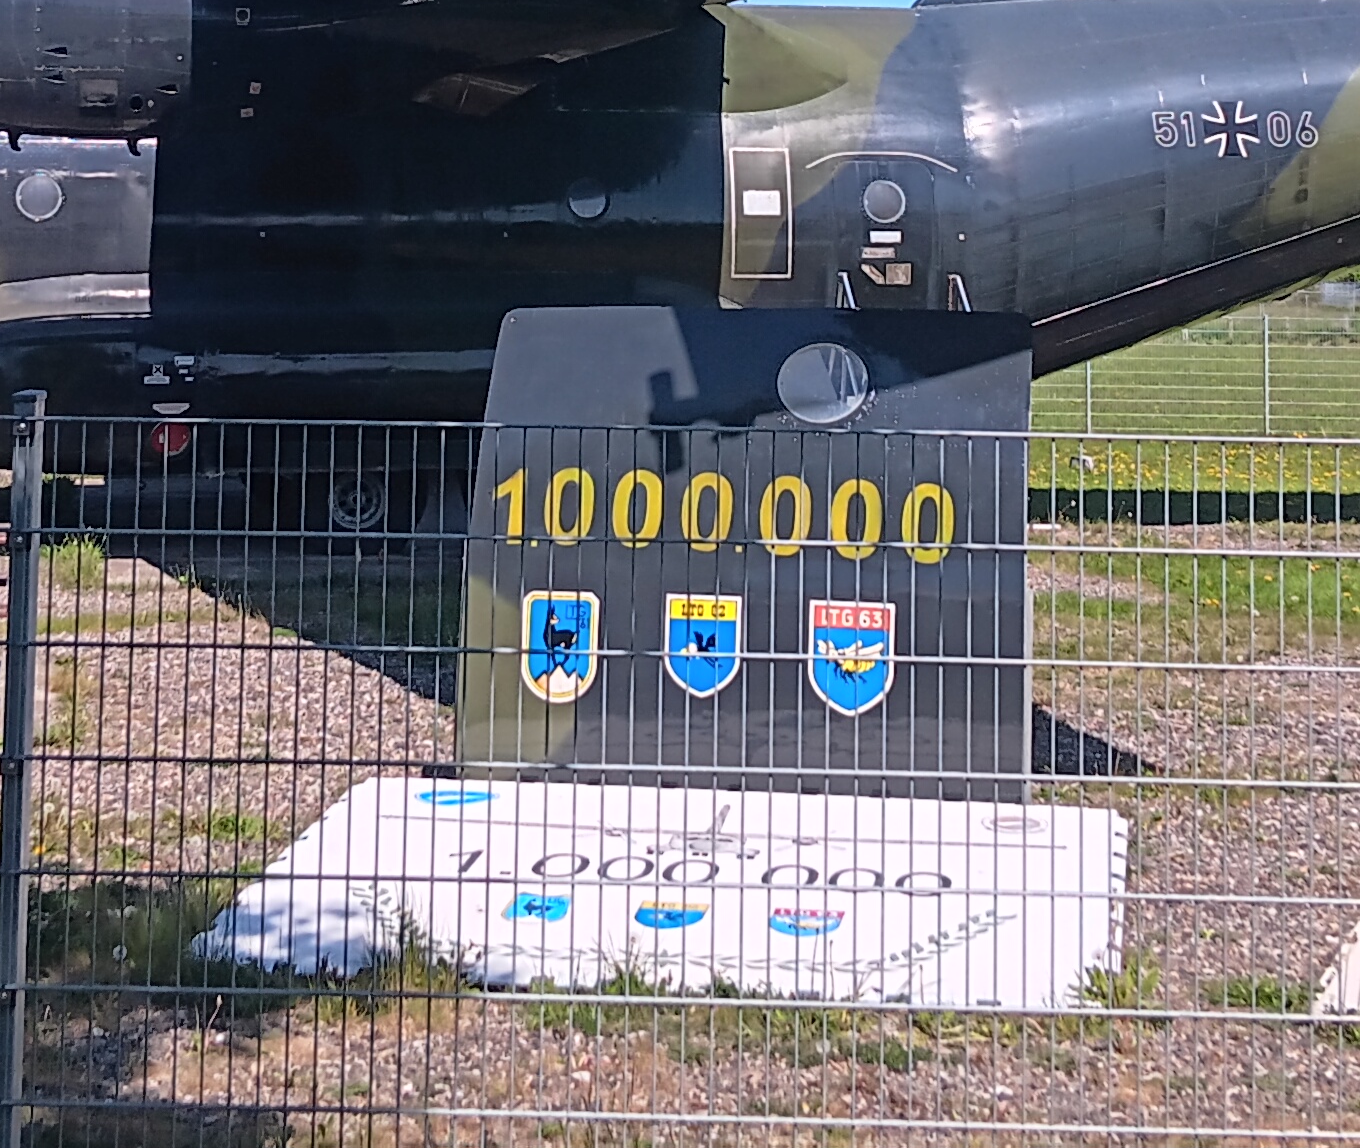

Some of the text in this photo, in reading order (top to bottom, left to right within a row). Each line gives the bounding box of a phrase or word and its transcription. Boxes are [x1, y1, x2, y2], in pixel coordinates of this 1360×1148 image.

[1151, 110, 1319, 148] 51 06
[491, 466, 956, 565] 1.000.000
[821, 608, 883, 628] LTG 63
